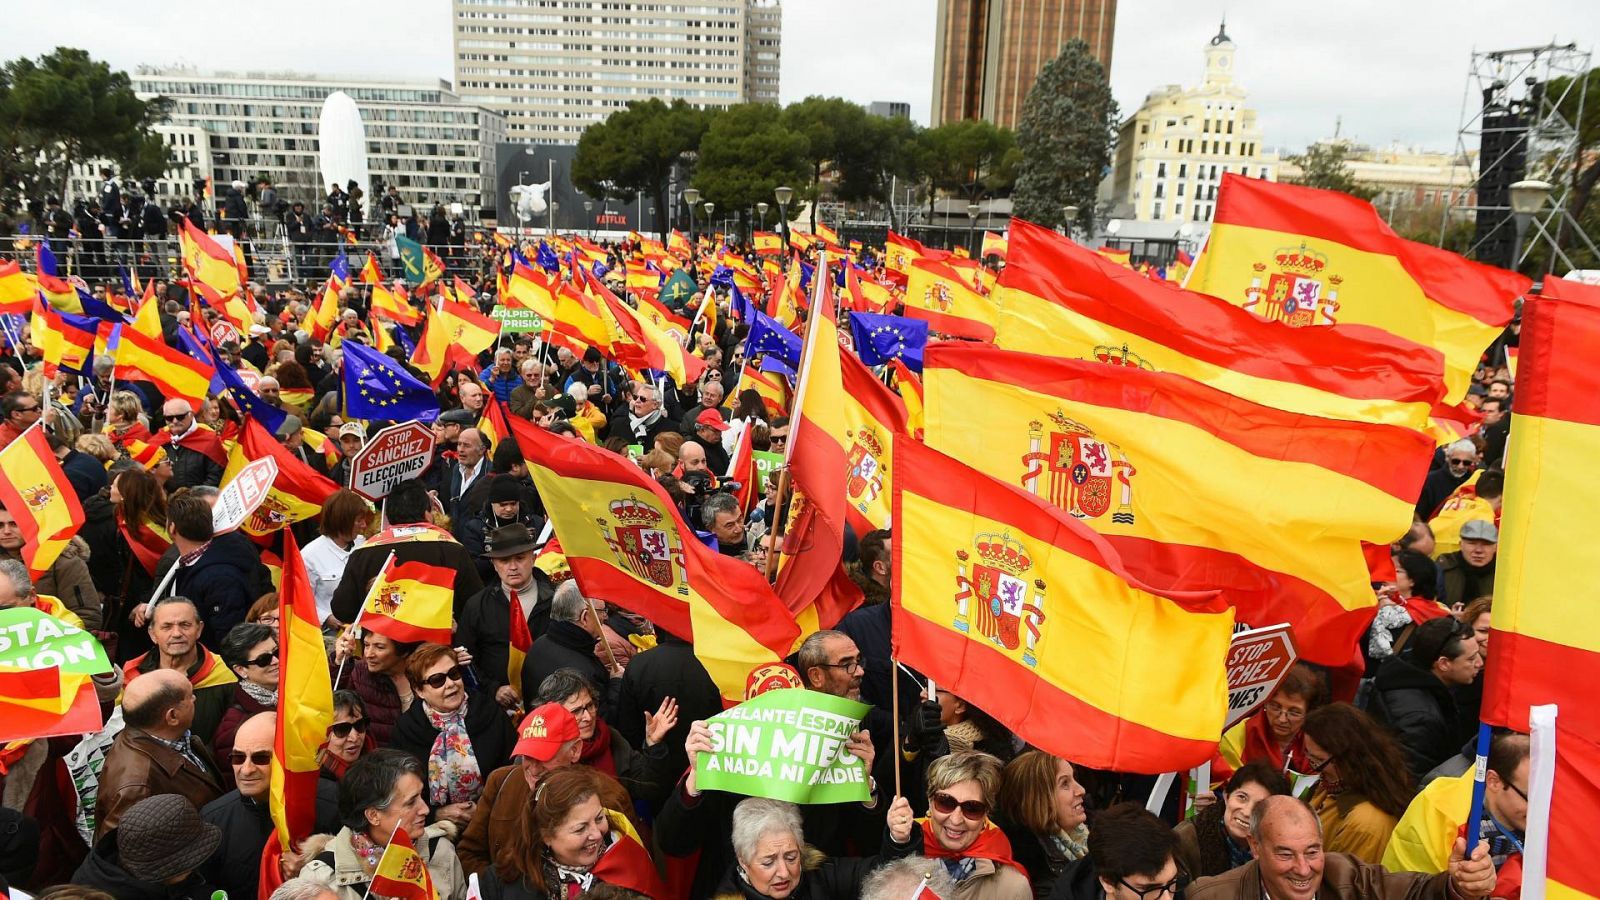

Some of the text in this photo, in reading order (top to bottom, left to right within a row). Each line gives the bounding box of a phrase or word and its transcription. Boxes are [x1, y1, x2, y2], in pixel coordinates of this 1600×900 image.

[596, 214, 627, 224] NETFLIX
[387, 430, 412, 447] STOP
[367, 438, 424, 468] SÁNCHEZ
[363, 455, 425, 487] ELECCIONES
[1228, 641, 1273, 666] STOP
[711, 707, 796, 724] DELANTE
[708, 723, 761, 754] SIN
[706, 755, 721, 771] A
[724, 755, 773, 778] NADA
[779, 766, 805, 785] NI
